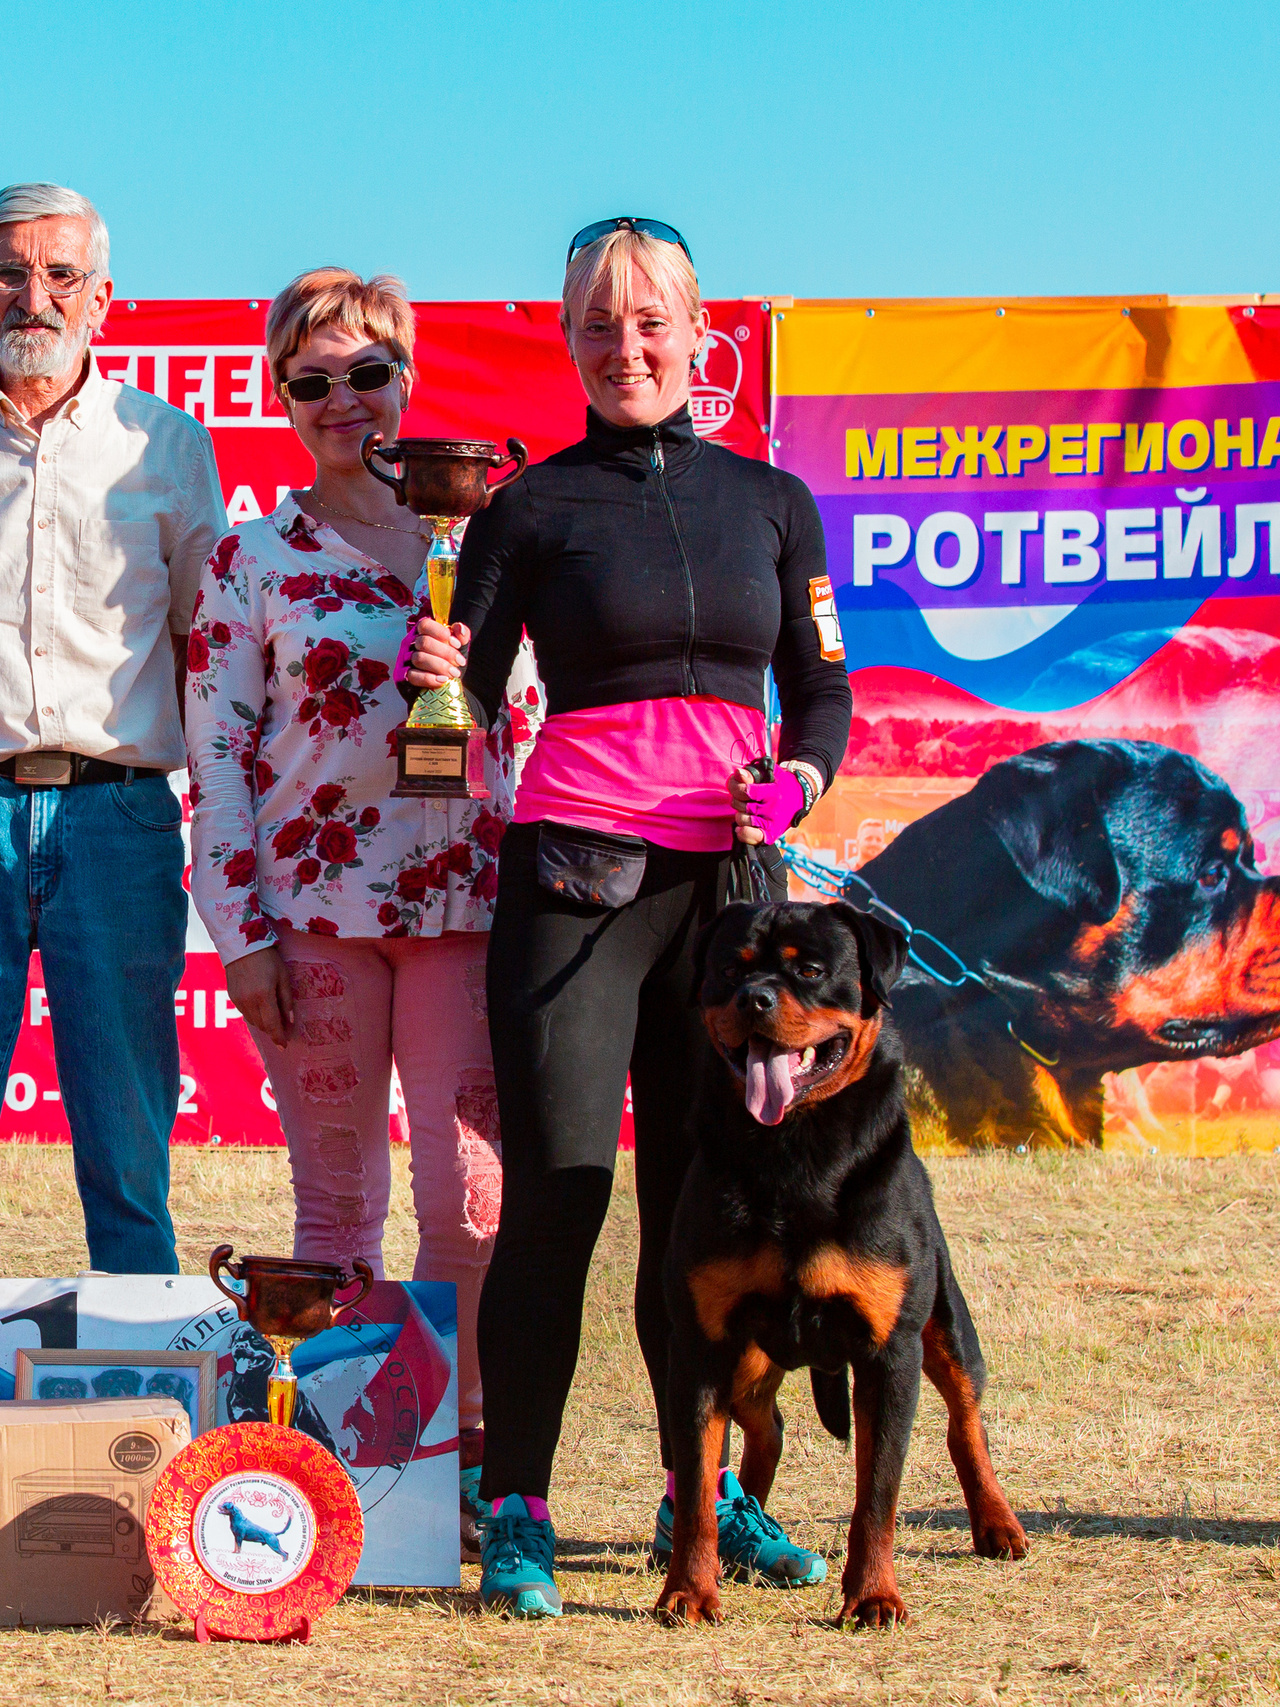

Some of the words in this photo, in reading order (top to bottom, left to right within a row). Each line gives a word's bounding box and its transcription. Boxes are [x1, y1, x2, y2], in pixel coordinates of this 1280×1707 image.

[853, 487, 1280, 587] РОТВЕЙЛ
[223, 1571, 236, 1582] Best
[236, 1577, 255, 1586] Junior
[256, 1577, 273, 1586] Show
